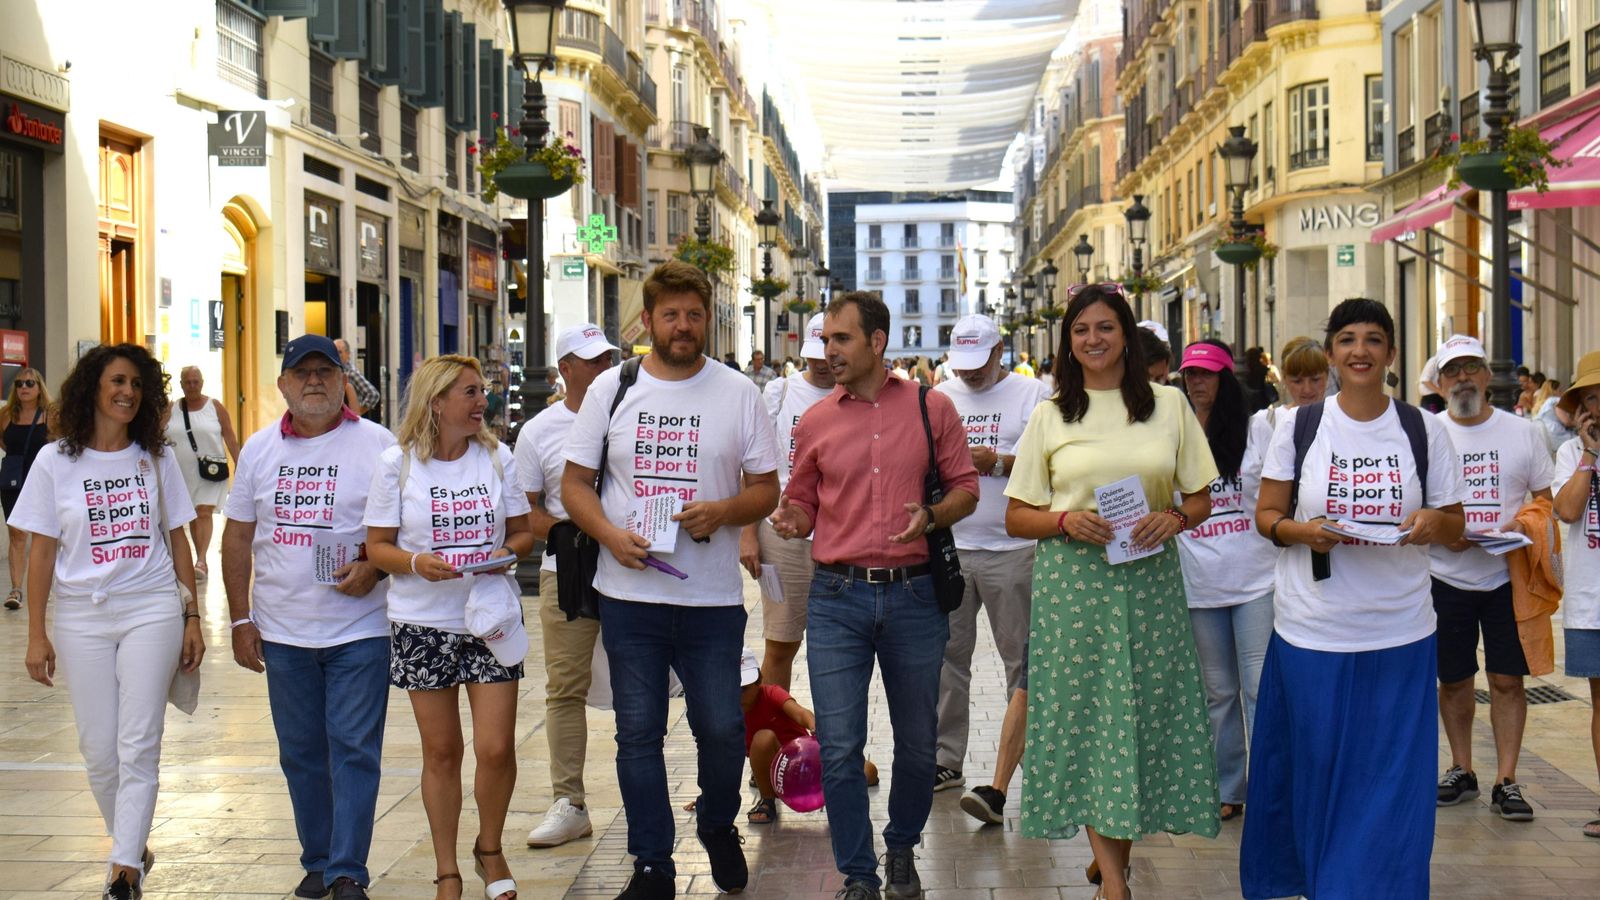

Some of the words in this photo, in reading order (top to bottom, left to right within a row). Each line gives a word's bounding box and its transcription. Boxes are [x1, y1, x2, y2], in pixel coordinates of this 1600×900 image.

[225, 112, 257, 144] V
[223, 148, 260, 156] VINCCI
[957, 337, 980, 345] Sumar
[638, 412, 655, 424] Es
[659, 415, 686, 428] por
[690, 415, 701, 427] ti
[967, 415, 989, 424] por
[992, 413, 1001, 422] ti
[636, 426, 654, 439] Es
[657, 430, 685, 443] por
[688, 429, 699, 442] ti
[991, 423, 999, 433] ti
[989, 435, 998, 445] ti
[635, 441, 652, 454] Es
[656, 445, 683, 459] por
[687, 444, 698, 457] ti
[1463, 453, 1486, 465] por
[1489, 450, 1498, 460] ti
[634, 456, 651, 470] Es
[655, 460, 682, 474] por
[686, 460, 696, 473] ti
[1353, 457, 1382, 472] por
[1386, 454, 1399, 468] ti
[1463, 465, 1486, 477] por
[1489, 462, 1499, 473] ti
[278, 466, 294, 477] Es
[297, 466, 324, 479] por
[327, 465, 338, 477] ti
[1329, 466, 1348, 482] Es
[1352, 473, 1383, 487] por
[1388, 469, 1401, 483] ti
[83, 479, 101, 492] Es
[105, 476, 131, 493] por
[134, 474, 145, 486] ti
[276, 478, 292, 490] Es
[295, 480, 322, 493] por
[325, 479, 336, 491] ti
[1232, 478, 1243, 491] ti
[1490, 475, 1499, 486] ti
[85, 492, 104, 506] Es
[107, 490, 133, 507] por
[137, 488, 148, 500] ti
[430, 487, 448, 499] Es
[477, 484, 488, 495] ti
[1327, 482, 1348, 498] Es
[1353, 488, 1386, 502] por
[1390, 485, 1402, 500] ti
[1490, 488, 1499, 499] ti
[274, 492, 291, 505] Es
[295, 495, 320, 508] por
[324, 493, 335, 506] ti
[431, 499, 449, 512] Es
[452, 500, 478, 515] por
[481, 496, 493, 508] ti
[1101, 499, 1113, 507] que
[88, 508, 105, 521] Es
[109, 504, 135, 522] por
[139, 501, 150, 514] ti
[274, 507, 290, 519] Es
[293, 509, 319, 523] por
[322, 508, 333, 521] ti
[1326, 499, 1347, 514] Es
[1352, 504, 1385, 519] por
[1389, 502, 1402, 517] ti
[1466, 511, 1501, 522] mar
[90, 523, 108, 537] Es
[111, 520, 137, 537] por
[140, 517, 150, 530] ti
[431, 514, 449, 528] Es
[453, 515, 481, 529] por
[484, 509, 495, 523] ti
[273, 528, 313, 547] Sum
[433, 529, 450, 542] Es
[454, 529, 481, 543] por
[485, 525, 495, 538] ti
[92, 544, 150, 564] Sumar
[777, 754, 789, 795] Sumar
